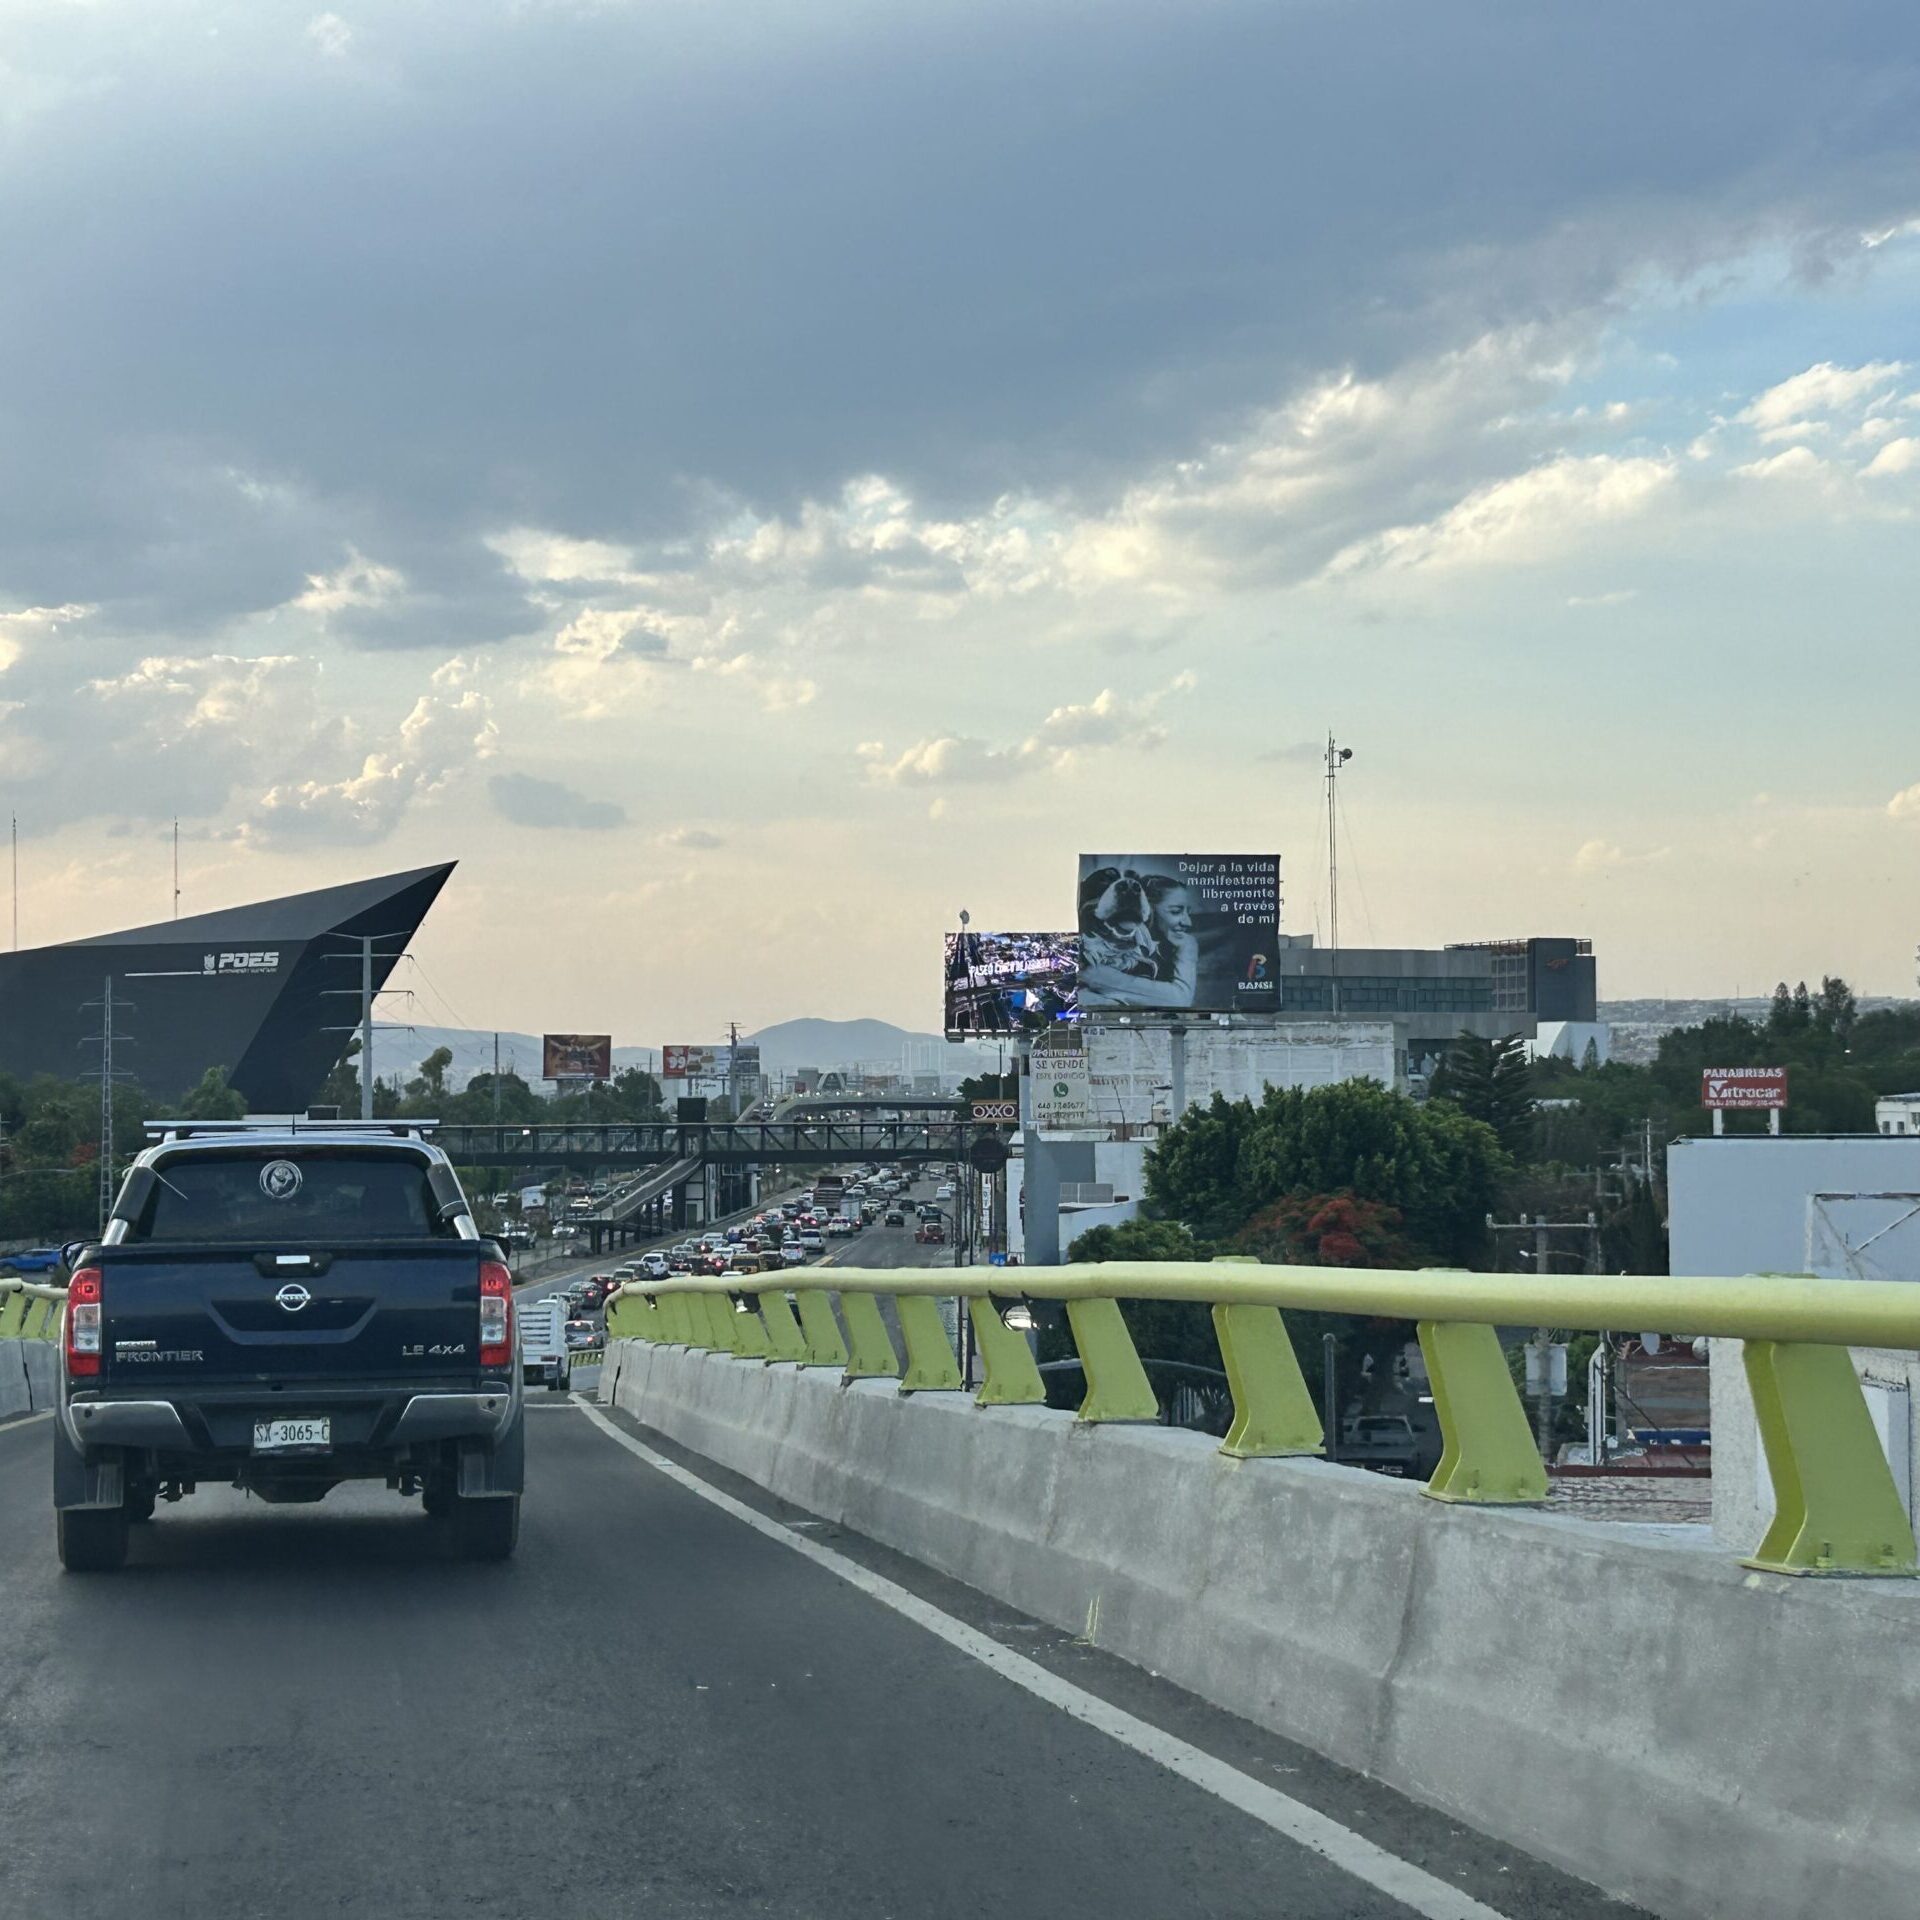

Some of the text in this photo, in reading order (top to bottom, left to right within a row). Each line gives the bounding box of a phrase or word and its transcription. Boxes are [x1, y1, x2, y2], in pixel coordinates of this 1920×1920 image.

[1179, 861, 1275, 874] Dejar a la vida
[1187, 875, 1275, 886] manifestarse
[1202, 888, 1275, 899] libremente
[1220, 900, 1275, 912] a través
[1237, 913, 1254, 924] de
[1035, 1059, 1085, 1070] SE VENDE
[1703, 1067, 1783, 1078] PARABRISAS
[973, 1104, 1015, 1119] OXXO
[402, 1344, 424, 1356] LE
[115, 1350, 204, 1362] FRONTIER
